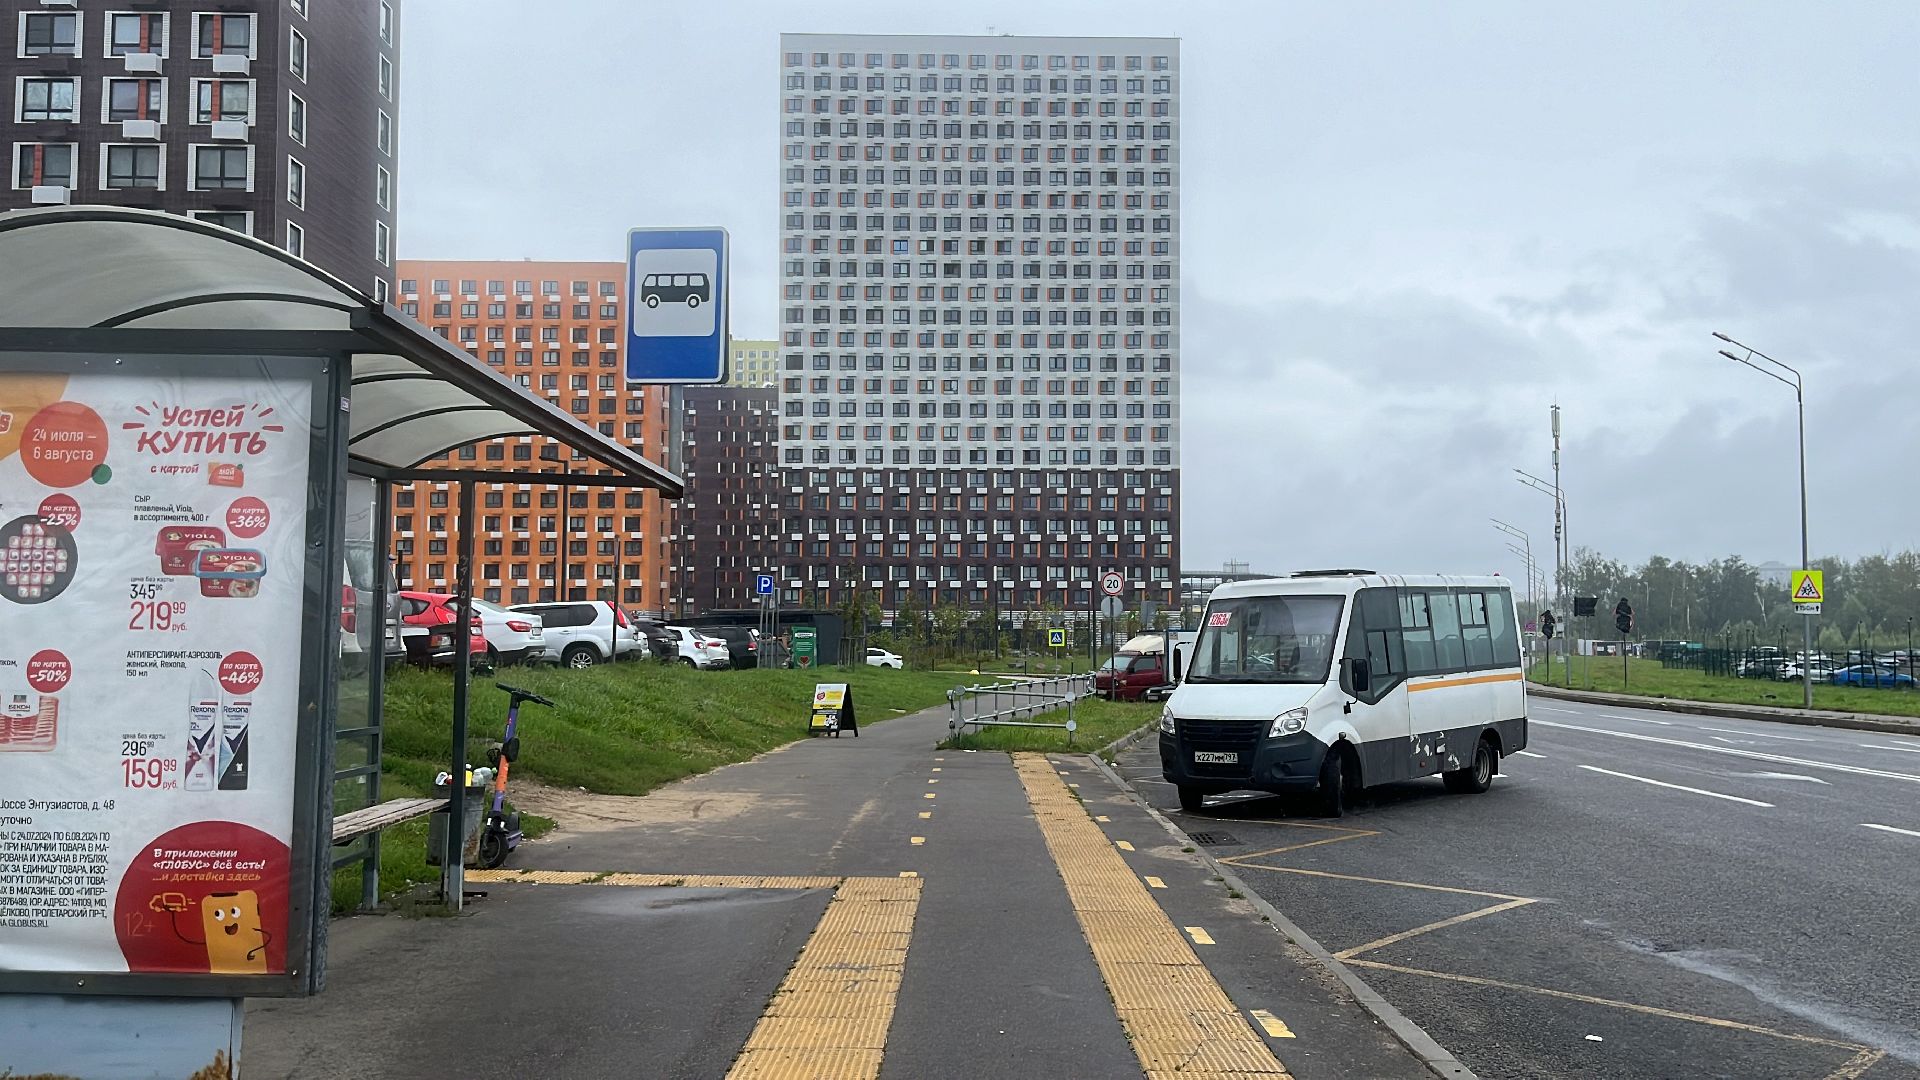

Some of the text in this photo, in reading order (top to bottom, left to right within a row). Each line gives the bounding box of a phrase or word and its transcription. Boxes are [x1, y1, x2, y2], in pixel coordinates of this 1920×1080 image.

[32, 428, 47, 441] 24
[50, 431, 84, 442] июля
[137, 430, 267, 456] КУПИТЬ
[33, 446, 94, 464] 6 августа
[150, 463, 200, 476] с картой
[134, 494, 151, 503] СЫР
[175, 504, 194, 513] Viola,
[40, 513, 77, 526] -25%
[190, 513, 205, 521] 400
[229, 515, 267, 528] -36%
[760, 577, 771, 592] P
[1106, 579, 1119, 589] 20
[128, 601, 173, 631] 219
[171, 622, 188, 633] руб.
[126, 650, 223, 659] АНТИПЕРСПИРАНТ-АЭРОЗОЛЬ
[42, 661, 67, 669] карте
[126, 660, 187, 670] женский, Rexona,
[234, 663, 259, 671] карте
[29, 669, 67, 682] -50%
[220, 671, 260, 684] -46%
[190, 705, 216, 714] Rexona
[223, 705, 249, 714] Rexona
[121, 740, 147, 756] 296
[121, 758, 163, 789] 159
[28, 798, 90, 812] Энтузиастов,
[91, 801, 101, 811] д.
[103, 799, 115, 810] 48
[53, 831, 64, 841] ПО
[99, 831, 110, 842] ПО
[3, 841, 110, 852] ПРИ НАЛИЧИИ ТОВАРА В МА-
[29, 853, 36, 863] И
[37, 853, 71, 864] УКАЗАНА
[72, 853, 78, 863] В
[153, 848, 238, 861] В приложении
[11, 863, 21, 873] ЗА
[22, 864, 58, 875] ЕДИНИЦУ
[89, 865, 109, 875] ИЗО-
[152, 859, 266, 870] «ГЛОБУС» всё есть!
[0, 875, 109, 886] МОГУТ ОТЛИЧАТЬСЯ ОТ ТОВА-
[170, 871, 225, 882] доставка
[226, 873, 261, 881] здесь
[9, 886, 15, 895] В
[43, 897, 70, 908] АДРЕС:
[31, 907, 88, 918] ПРОЛЕТАРСКИЙ
[124, 912, 156, 937] 12+
